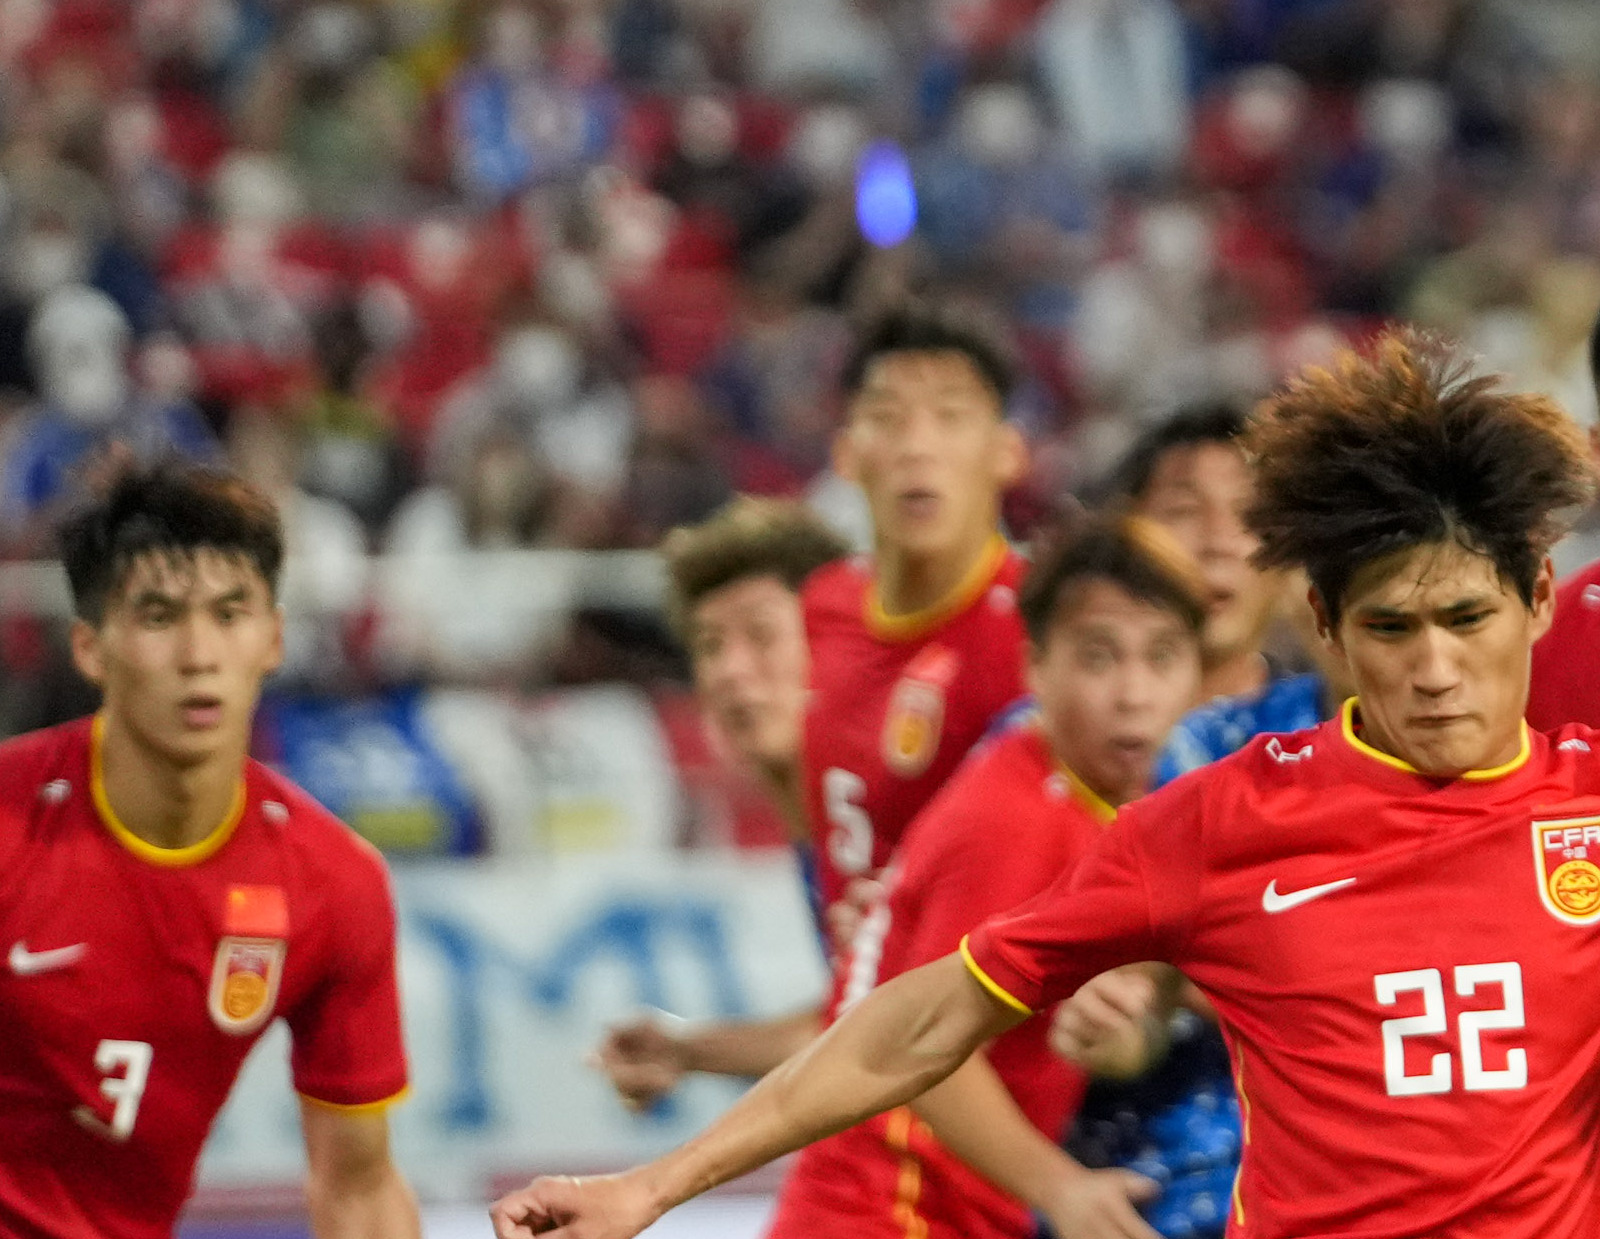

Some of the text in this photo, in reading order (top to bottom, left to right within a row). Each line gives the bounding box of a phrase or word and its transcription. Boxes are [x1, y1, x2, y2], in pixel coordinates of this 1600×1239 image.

[822, 766, 873, 874] 5
[1373, 961, 1528, 1096] 22
[72, 1039, 153, 1142] 3
